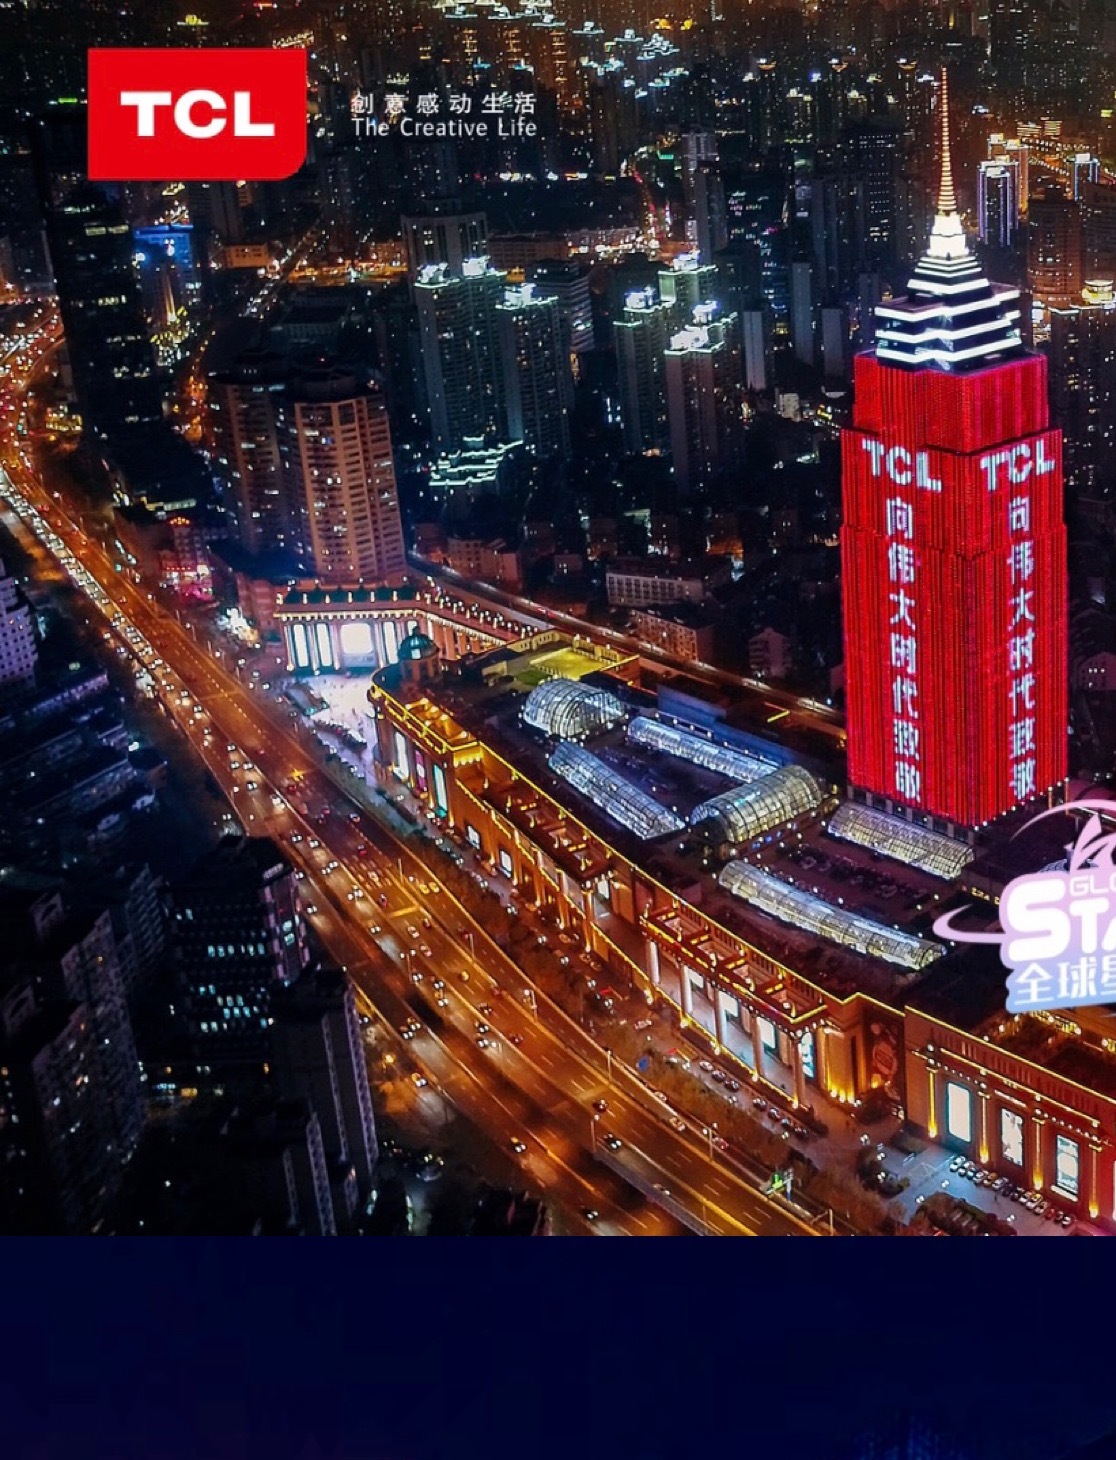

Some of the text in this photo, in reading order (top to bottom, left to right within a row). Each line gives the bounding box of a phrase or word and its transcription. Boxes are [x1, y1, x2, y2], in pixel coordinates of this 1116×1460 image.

[862, 440, 942, 491] TCL
[980, 440, 1056, 490] TCL
[885, 497, 920, 802] 向伟大时代致敬
[1007, 498, 1036, 800] 向伟大时代致敬
